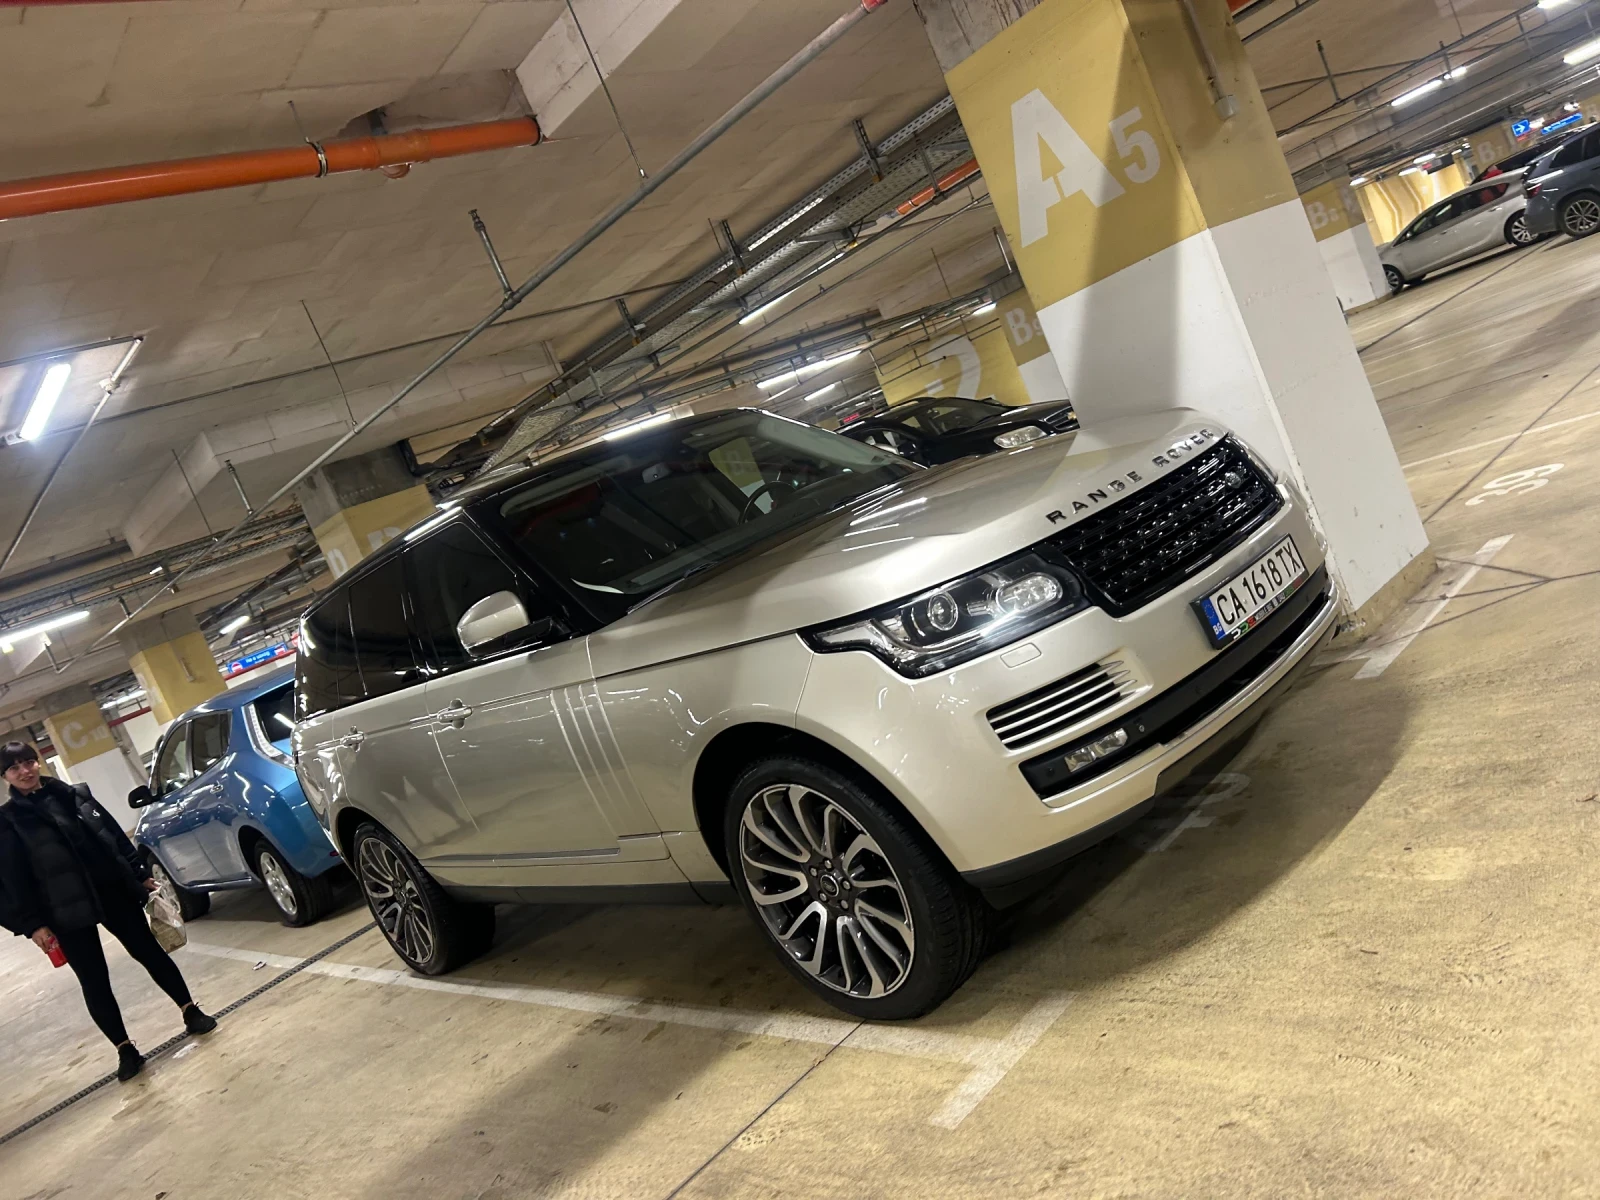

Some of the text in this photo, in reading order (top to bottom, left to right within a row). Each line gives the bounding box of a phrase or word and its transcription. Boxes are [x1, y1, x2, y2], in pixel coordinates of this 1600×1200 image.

[1045, 428, 1216, 525] RANGE ROVER
[1216, 587, 1247, 626] CA
[1242, 558, 1282, 605] 1618
[1275, 543, 1301, 577] TX
